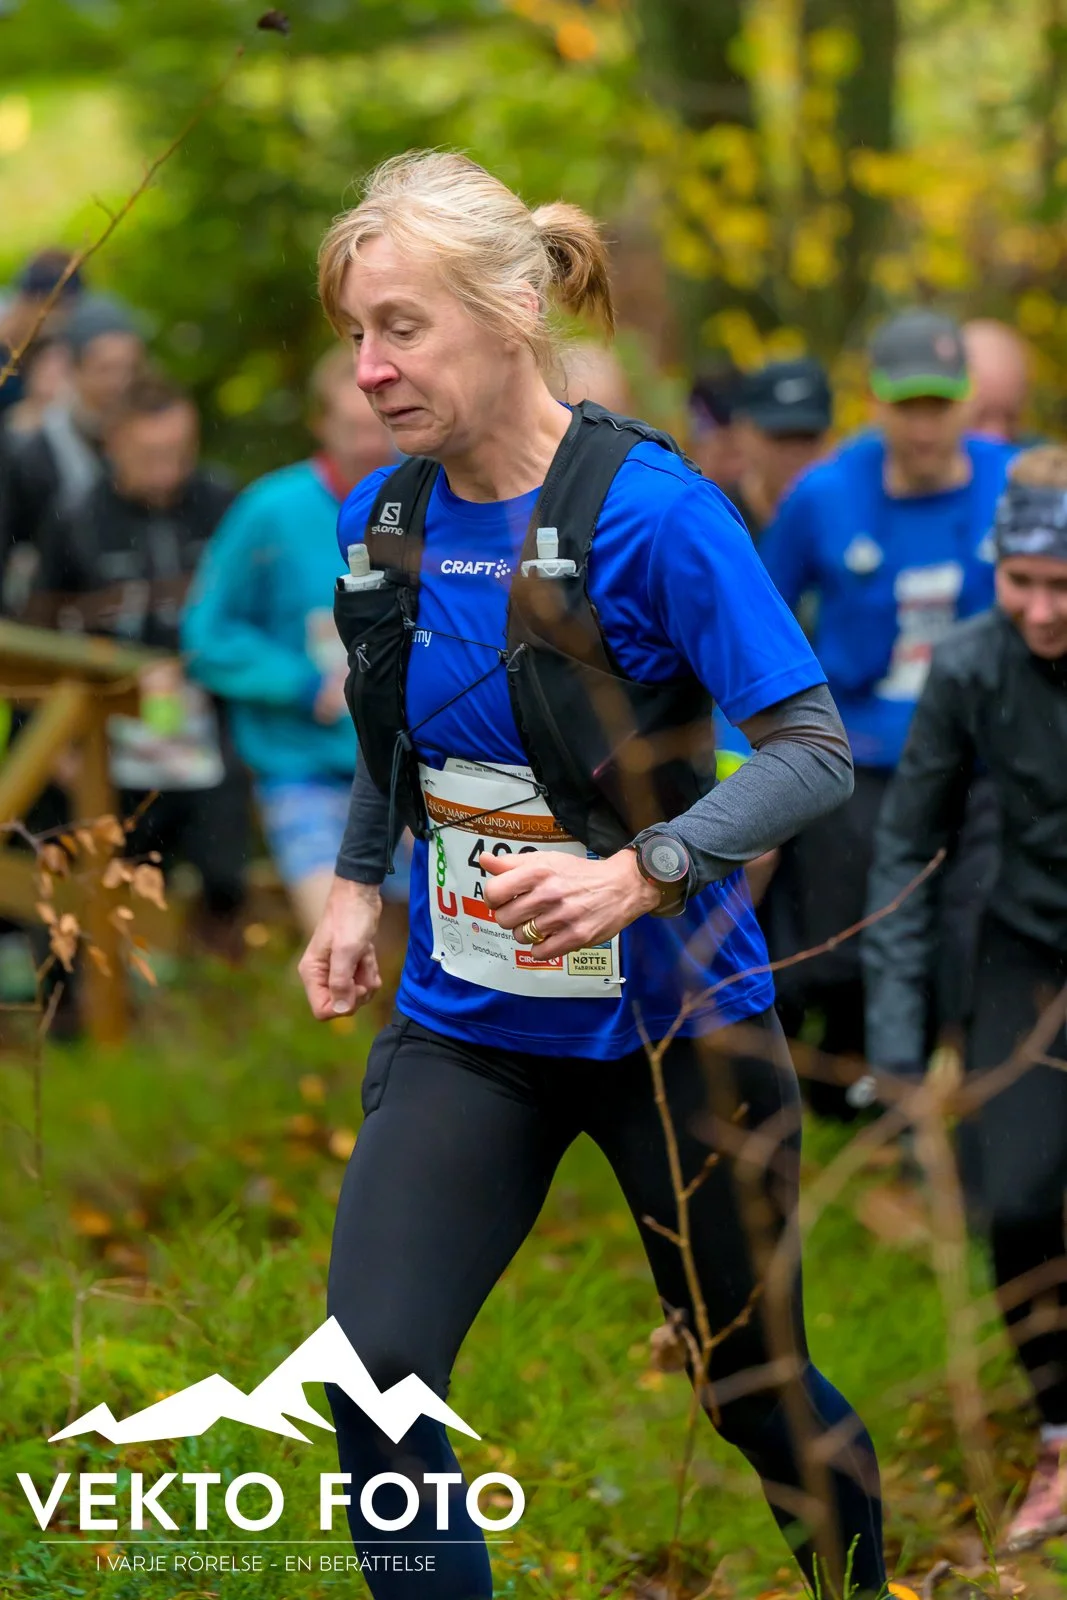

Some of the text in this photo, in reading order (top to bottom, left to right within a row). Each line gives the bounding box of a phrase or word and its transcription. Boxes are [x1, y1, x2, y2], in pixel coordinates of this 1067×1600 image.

[440, 559, 496, 575] CRAFT
[480, 926, 516, 941] kolmardsru
[573, 956, 607, 965] NØTTE
